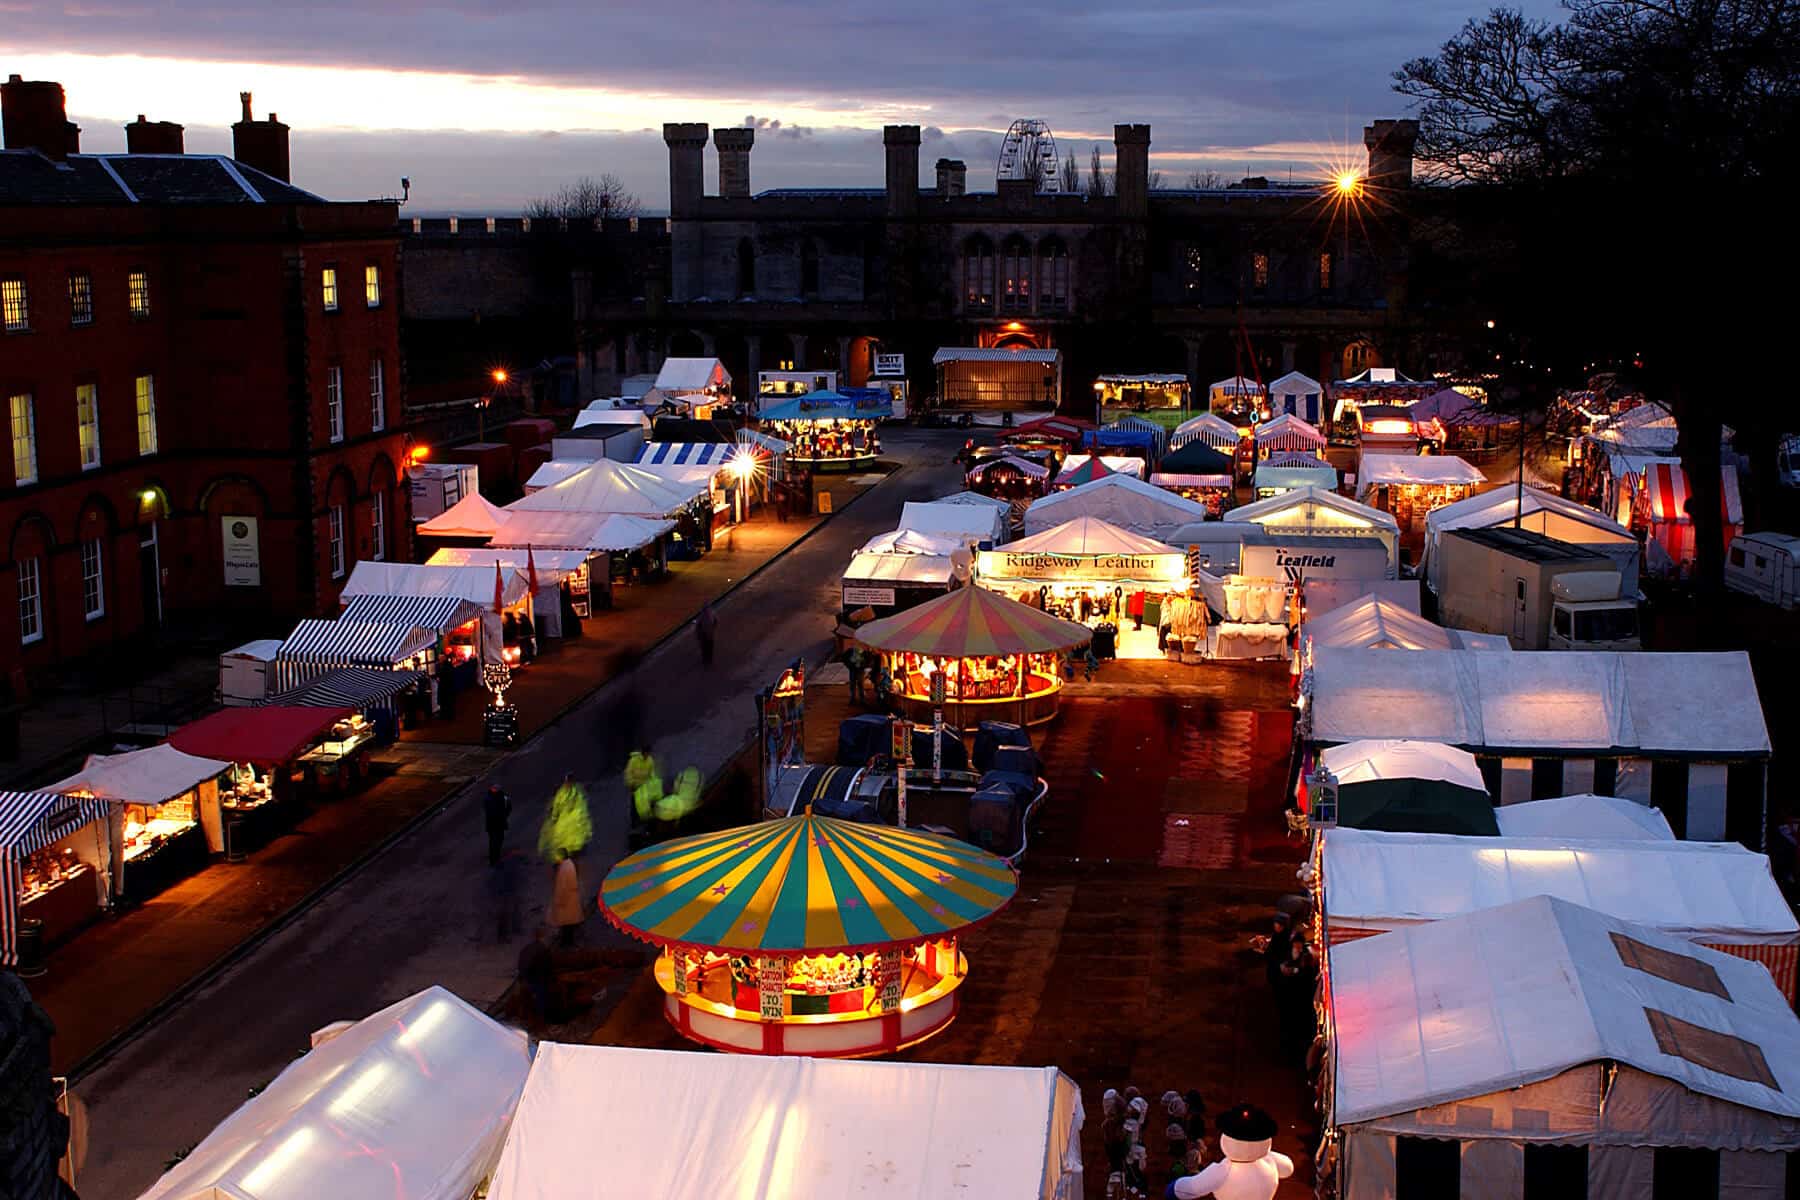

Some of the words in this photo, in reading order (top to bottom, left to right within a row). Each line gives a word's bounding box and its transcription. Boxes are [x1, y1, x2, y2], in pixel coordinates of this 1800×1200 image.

[878, 355, 900, 363] EXIT
[1007, 553, 1082, 571] Ridgeway
[1094, 554, 1155, 569] Leather
[1276, 554, 1336, 568] Leafield
[762, 970, 782, 980] CARTOON
[886, 985, 898, 996] TO
[766, 995, 779, 1006] TO
[762, 1006, 782, 1017] WIN
